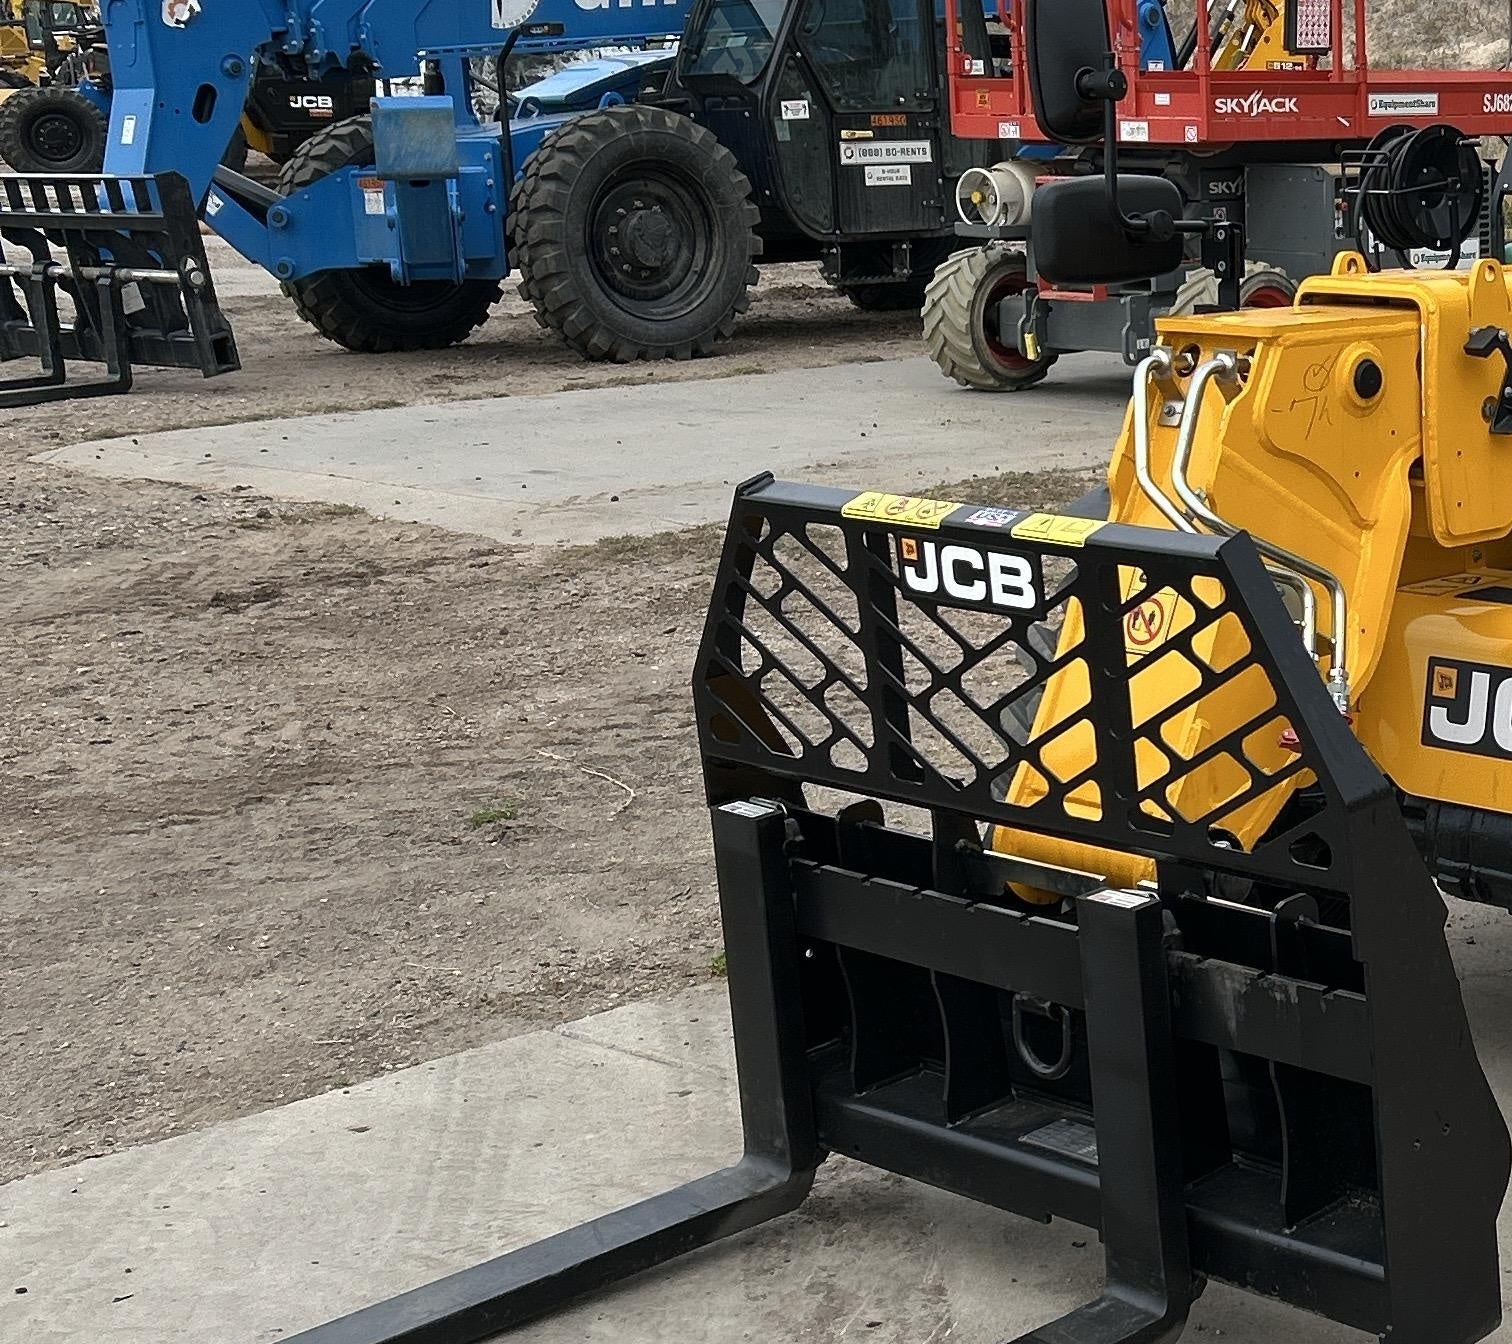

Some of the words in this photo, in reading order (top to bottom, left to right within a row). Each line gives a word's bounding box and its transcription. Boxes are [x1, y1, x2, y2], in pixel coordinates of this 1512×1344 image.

[289, 95, 333, 108] JCB
[1214, 89, 1299, 117] SKYJACK
[904, 539, 1038, 611] JCB
